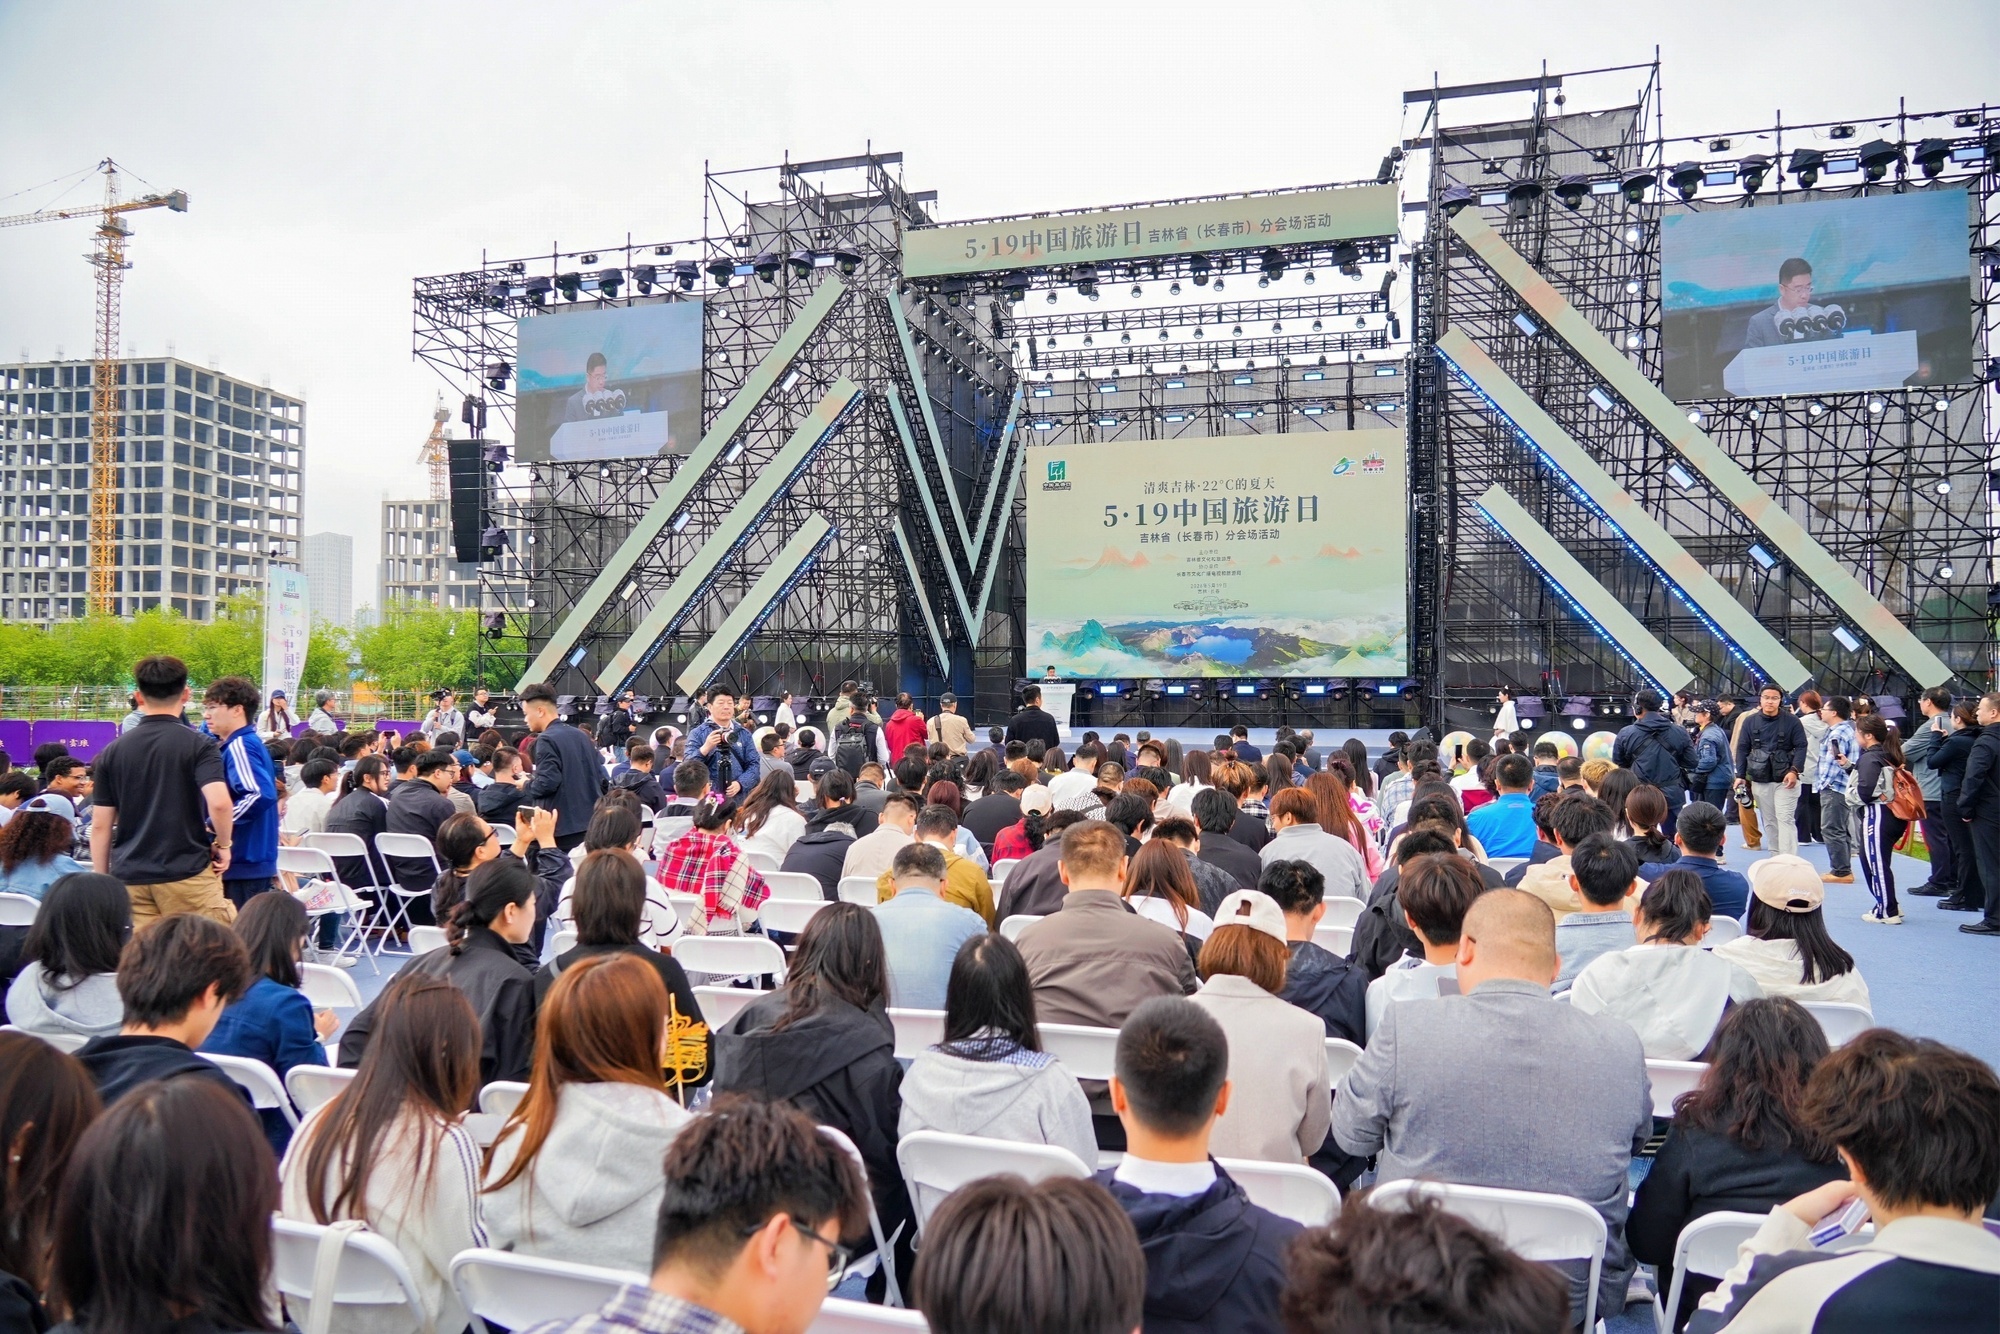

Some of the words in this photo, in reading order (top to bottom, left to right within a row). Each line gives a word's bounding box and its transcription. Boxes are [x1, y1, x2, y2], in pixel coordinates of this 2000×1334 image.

[964, 220, 1142, 260] 5·19中国旅游日
[1148, 212, 1332, 244] 吉林省（长春市）分会场活动
[1787, 346, 1872, 367] 5·19中国旅游日
[1103, 494, 1319, 528] 5·19中国旅游日
[1139, 528, 1281, 544] 吉林省（长春市）分会场活动
